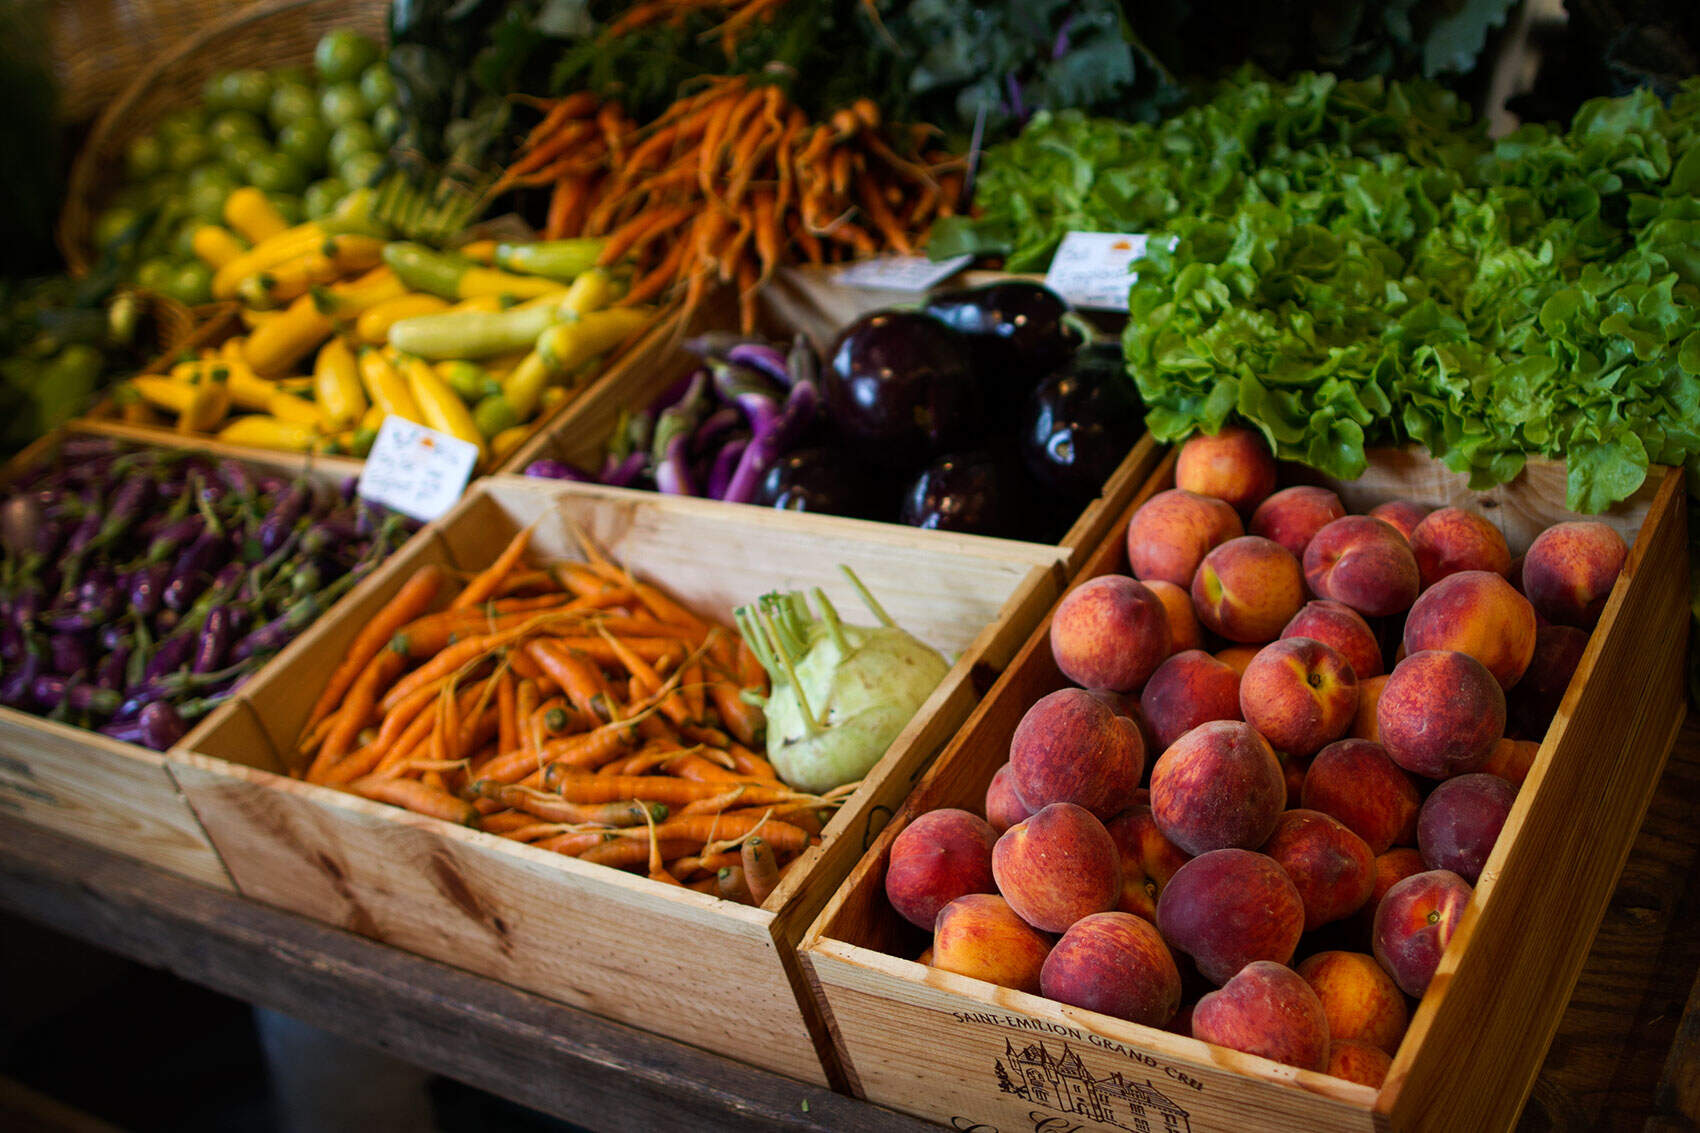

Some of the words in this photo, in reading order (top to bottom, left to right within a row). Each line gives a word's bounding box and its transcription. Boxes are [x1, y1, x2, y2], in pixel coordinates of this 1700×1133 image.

[952, 1011, 1081, 1041] SAINT-EMILION
[1088, 1035, 1158, 1068] GRAND
[1164, 1066, 1204, 1091] CRU
